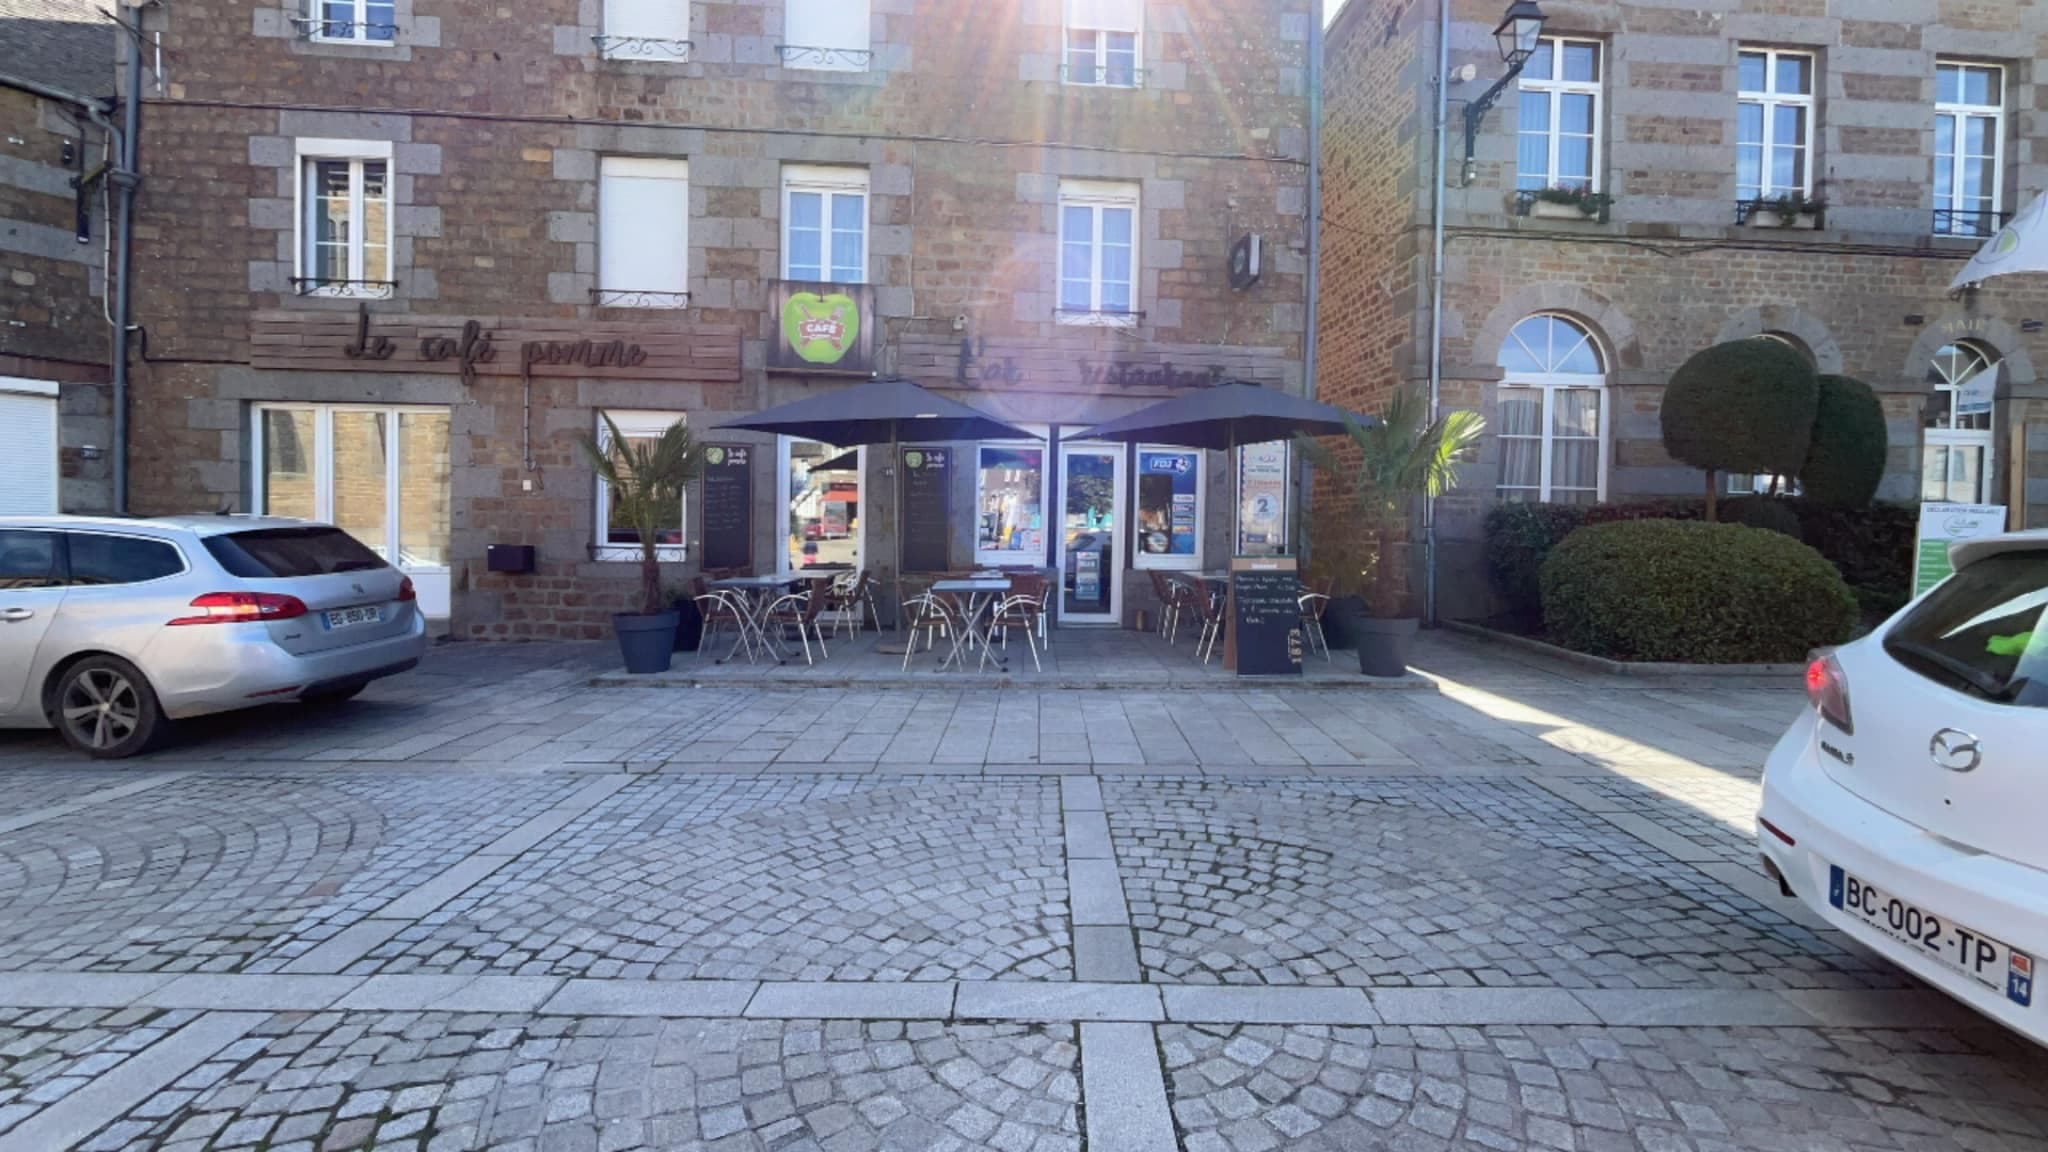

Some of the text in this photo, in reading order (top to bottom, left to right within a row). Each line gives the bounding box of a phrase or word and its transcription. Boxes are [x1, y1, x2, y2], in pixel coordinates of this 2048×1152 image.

[344, 302, 396, 360] Le
[521, 339, 648, 382] pomme
[1257, 498, 1269, 513] 2
[1846, 877, 1997, 973] BC-002-TP
[2012, 978, 2028, 997] 14
